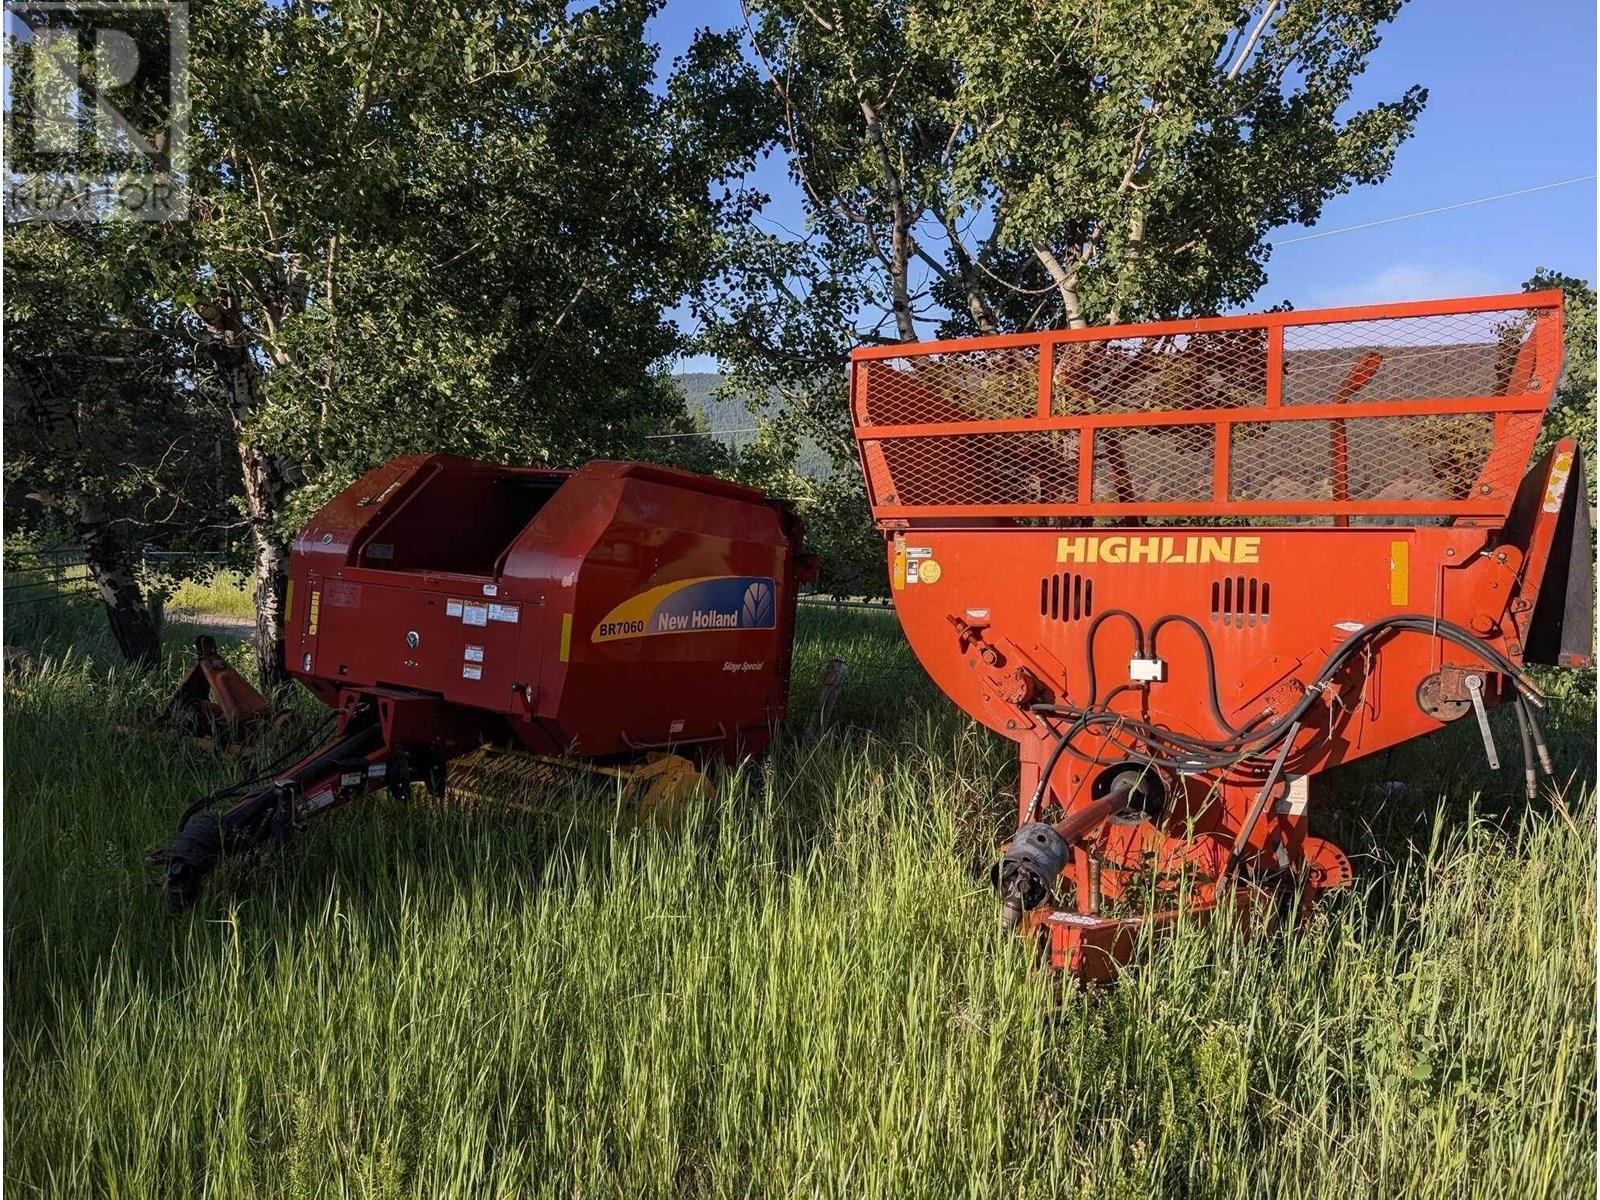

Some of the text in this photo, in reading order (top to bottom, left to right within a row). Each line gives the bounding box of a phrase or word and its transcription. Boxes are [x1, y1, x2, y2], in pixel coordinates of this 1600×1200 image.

[1056, 536, 1261, 563] HIGHLINE
[600, 620, 644, 637] BR7060
[658, 610, 738, 631] New Holland
[722, 661, 764, 673] Silage Special
